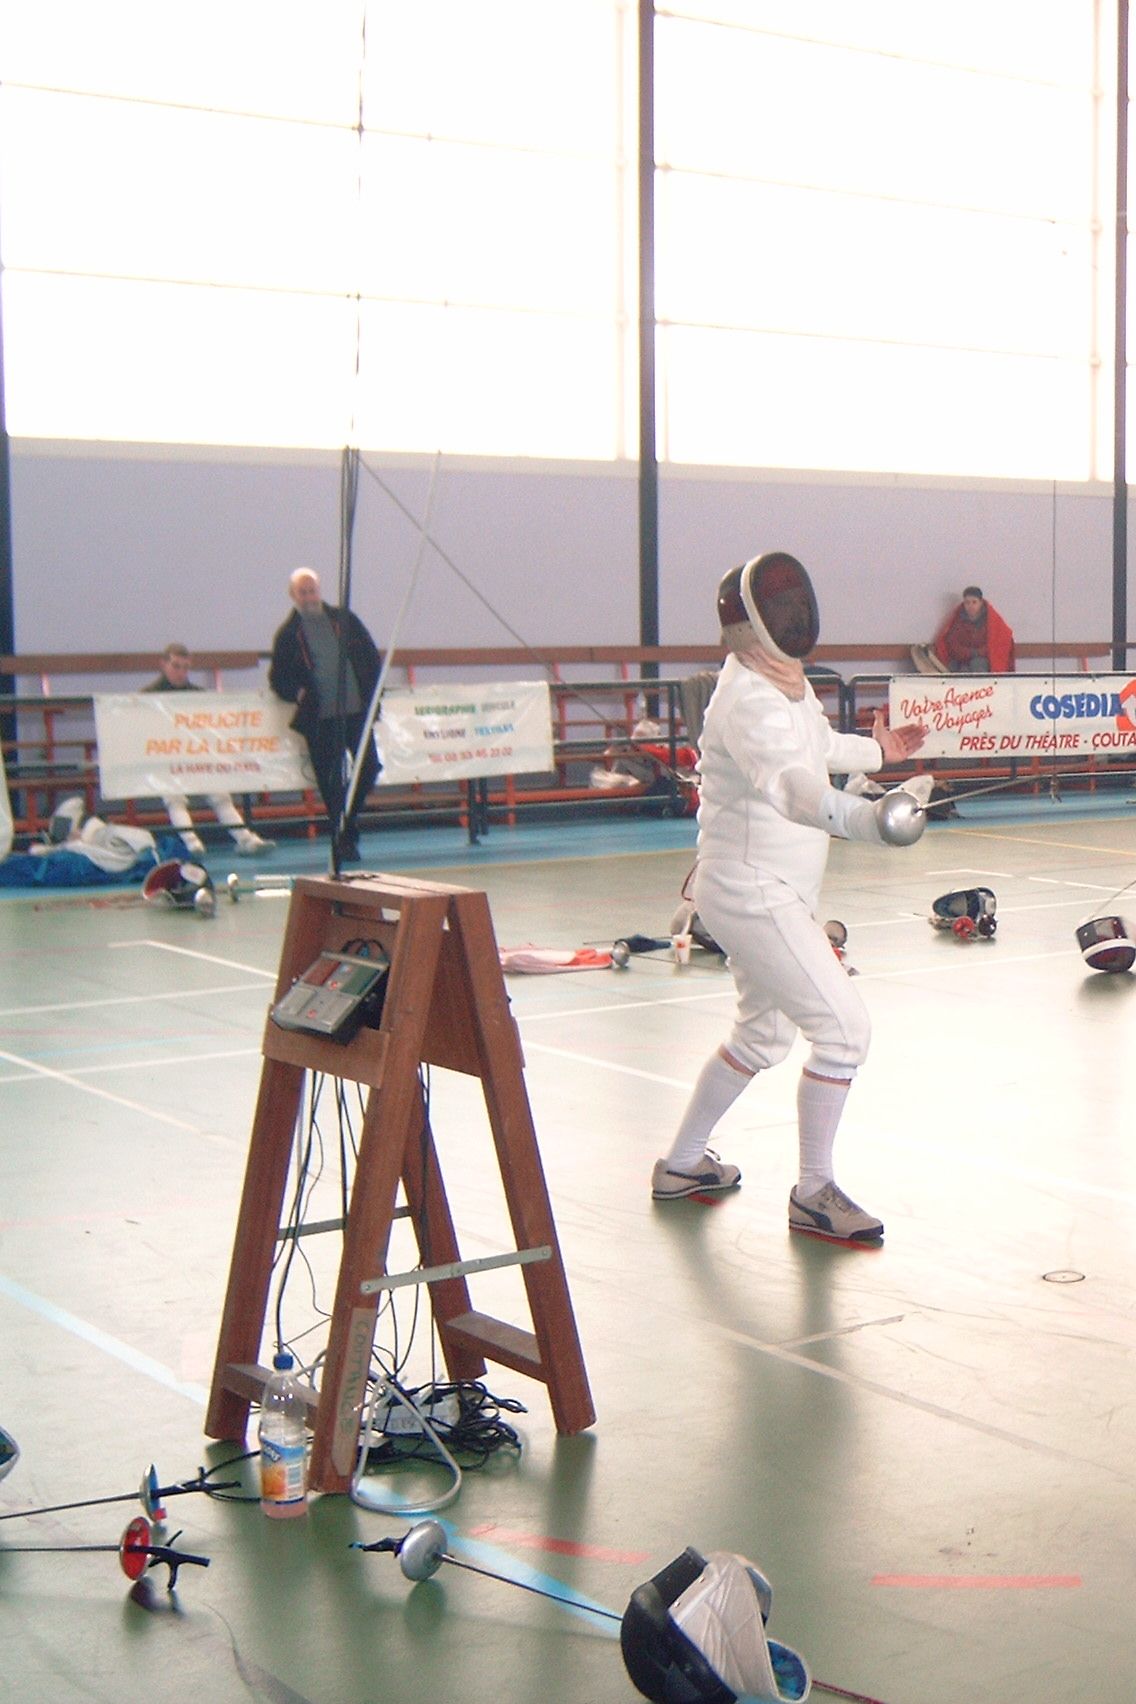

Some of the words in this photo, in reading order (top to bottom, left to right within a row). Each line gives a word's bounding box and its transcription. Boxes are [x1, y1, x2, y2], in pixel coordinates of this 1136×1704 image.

[901, 696, 943, 719] Votre
[944, 686, 994, 712] Agence
[932, 705, 993, 733] Voyages
[145, 736, 181, 755] PAR
[186, 737, 209, 755] LA
[216, 735, 280, 754] LETTRE
[960, 731, 996, 751] PRÈS
[1000, 735, 1022, 750] DU
